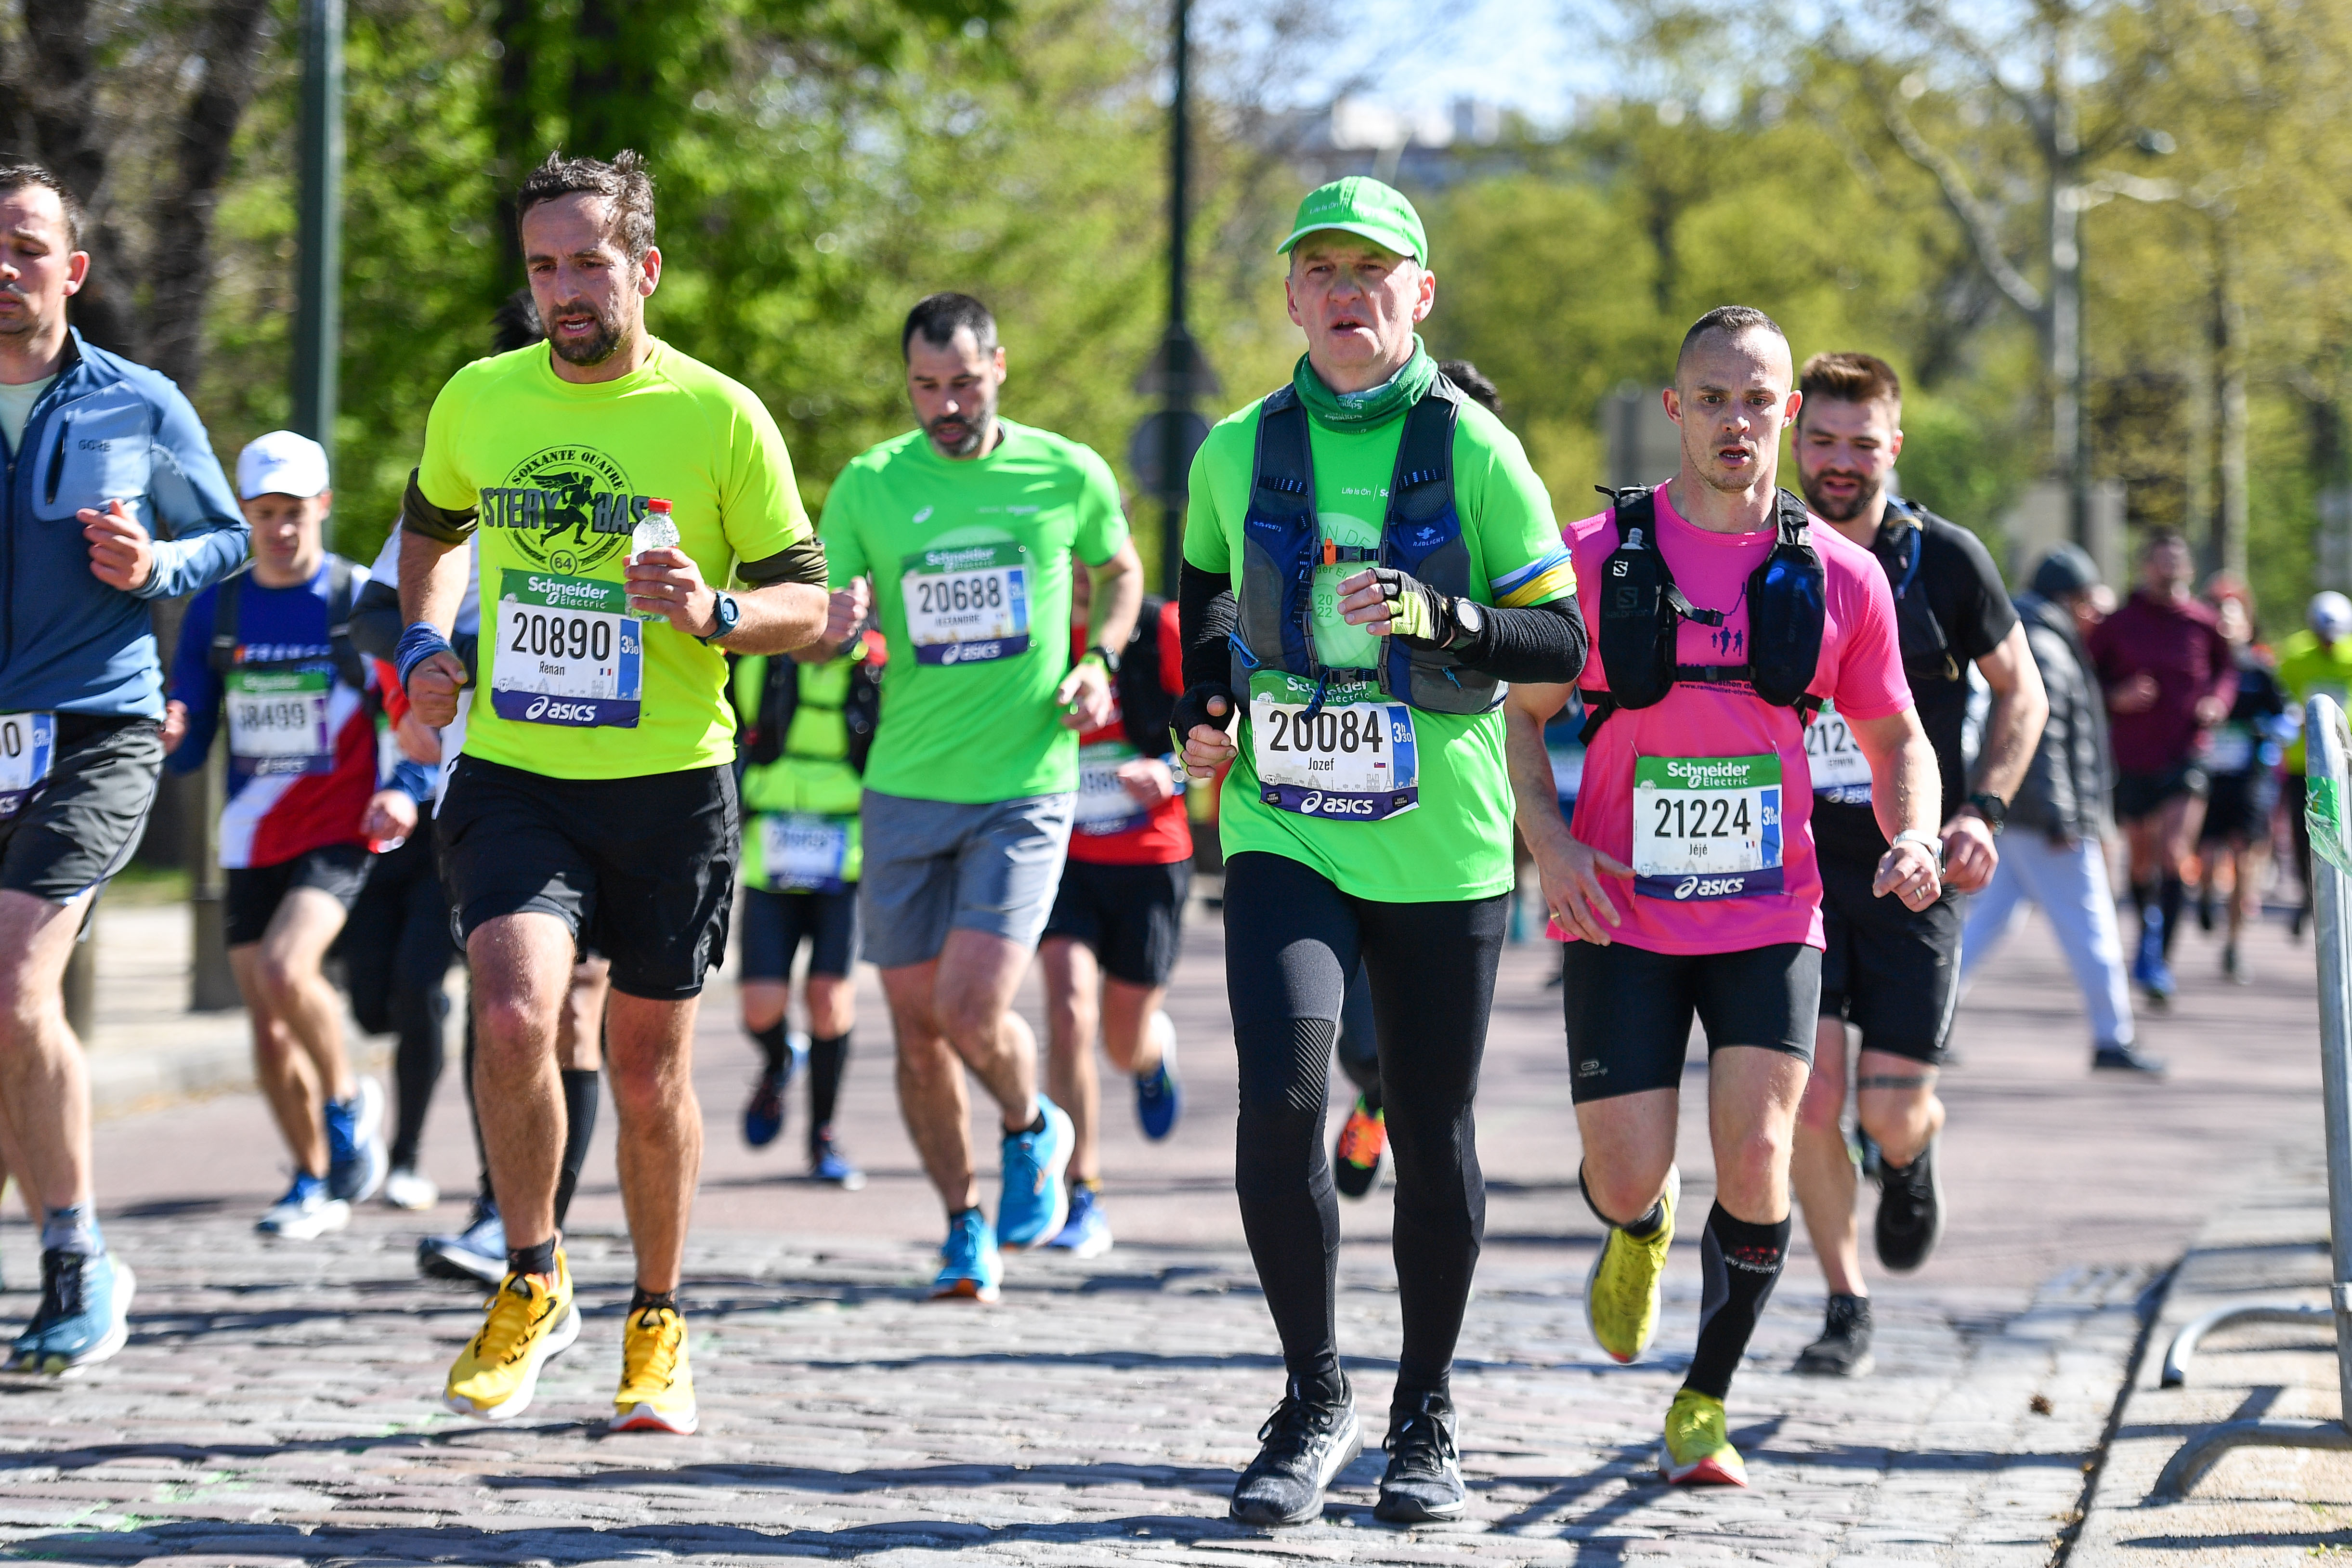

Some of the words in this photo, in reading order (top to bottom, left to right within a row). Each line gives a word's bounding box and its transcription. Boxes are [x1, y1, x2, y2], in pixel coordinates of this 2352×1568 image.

[78, 439, 111, 452] GORE
[511, 449, 576, 485] SOIXANTE
[580, 452, 625, 491] QUATRE
[554, 557, 573, 569] 64
[528, 576, 610, 600] Schneider
[918, 577, 1000, 613] 20688
[560, 596, 607, 609] Electric
[1317, 594, 1333, 606] 20
[1317, 606, 1332, 618] 22
[510, 612, 611, 662] 20890
[538, 661, 565, 677] Renan
[1286, 677, 1370, 696] Scheider
[547, 703, 598, 722] asics
[1269, 709, 1383, 753] 20084
[1806, 721, 1861, 755] 212
[1308, 757, 1335, 771] Jozef
[1667, 761, 1751, 777] Schneider
[1703, 777, 1749, 787] Electric
[1323, 797, 1374, 814] asics
[1654, 798, 1751, 838] 21224
[1689, 843, 1708, 858] Jéjé
[1696, 877, 1745, 896] asics
